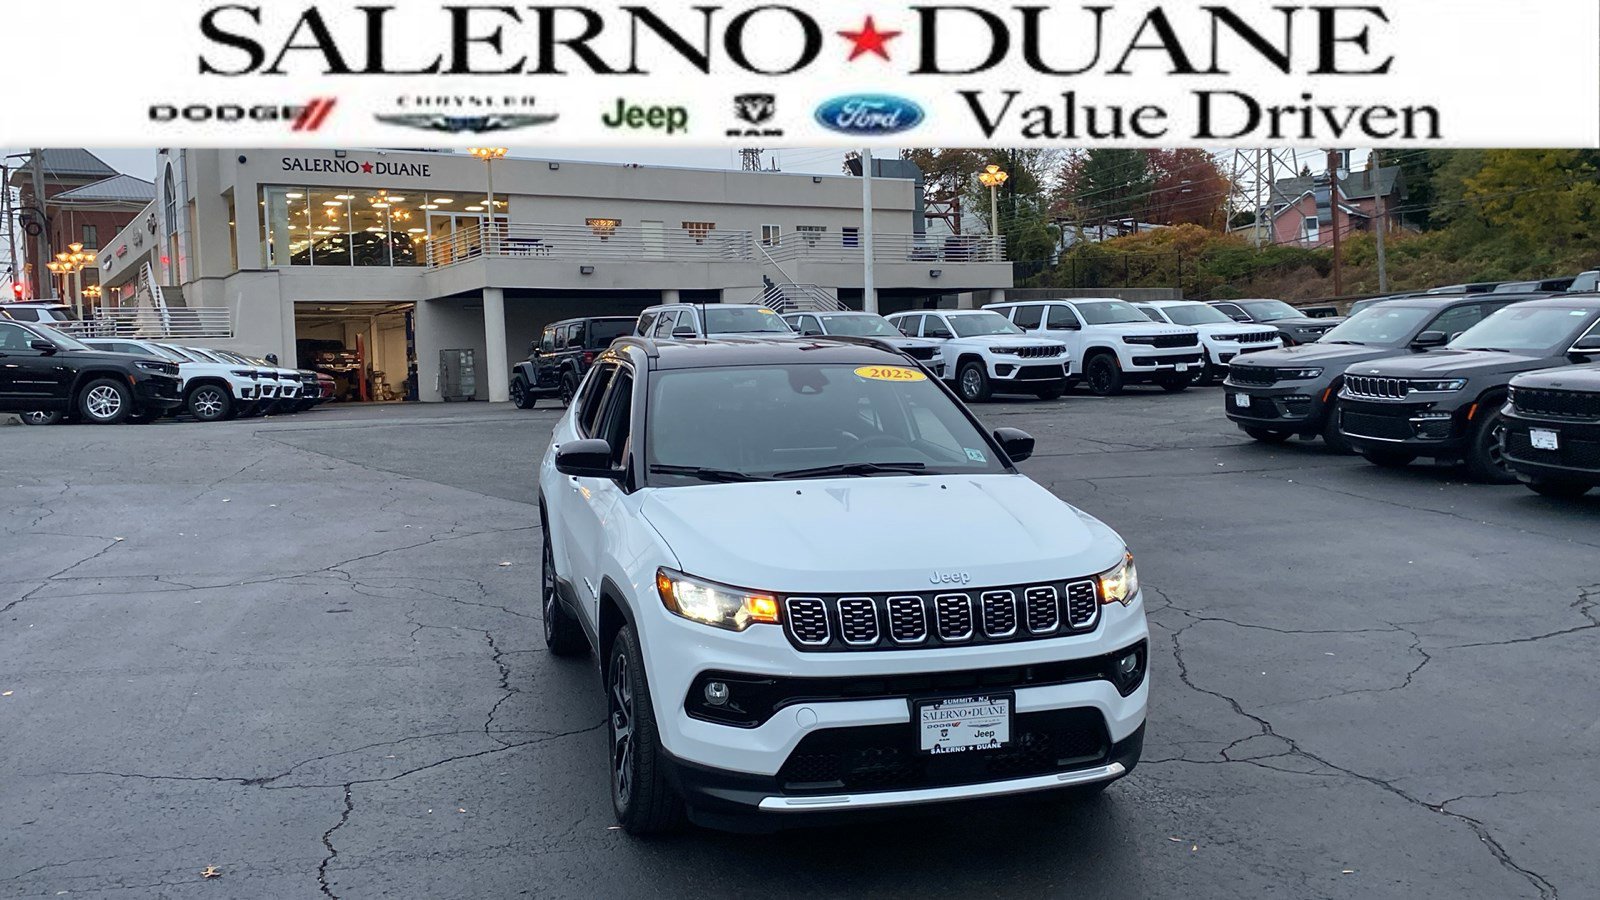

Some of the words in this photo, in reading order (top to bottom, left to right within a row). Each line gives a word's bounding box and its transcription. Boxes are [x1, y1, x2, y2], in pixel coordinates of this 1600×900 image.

[282, 157, 359, 174] SALERNO
[375, 161, 431, 177] DUANE
[870, 367, 914, 380] 2025
[929, 570, 970, 585] Jeep
[922, 708, 967, 721] SALERNO
[972, 705, 1006, 717] DUANE
[974, 729, 995, 739] Jeep
[930, 746, 966, 755] SALERNO
[976, 742, 1002, 751] DUANE
